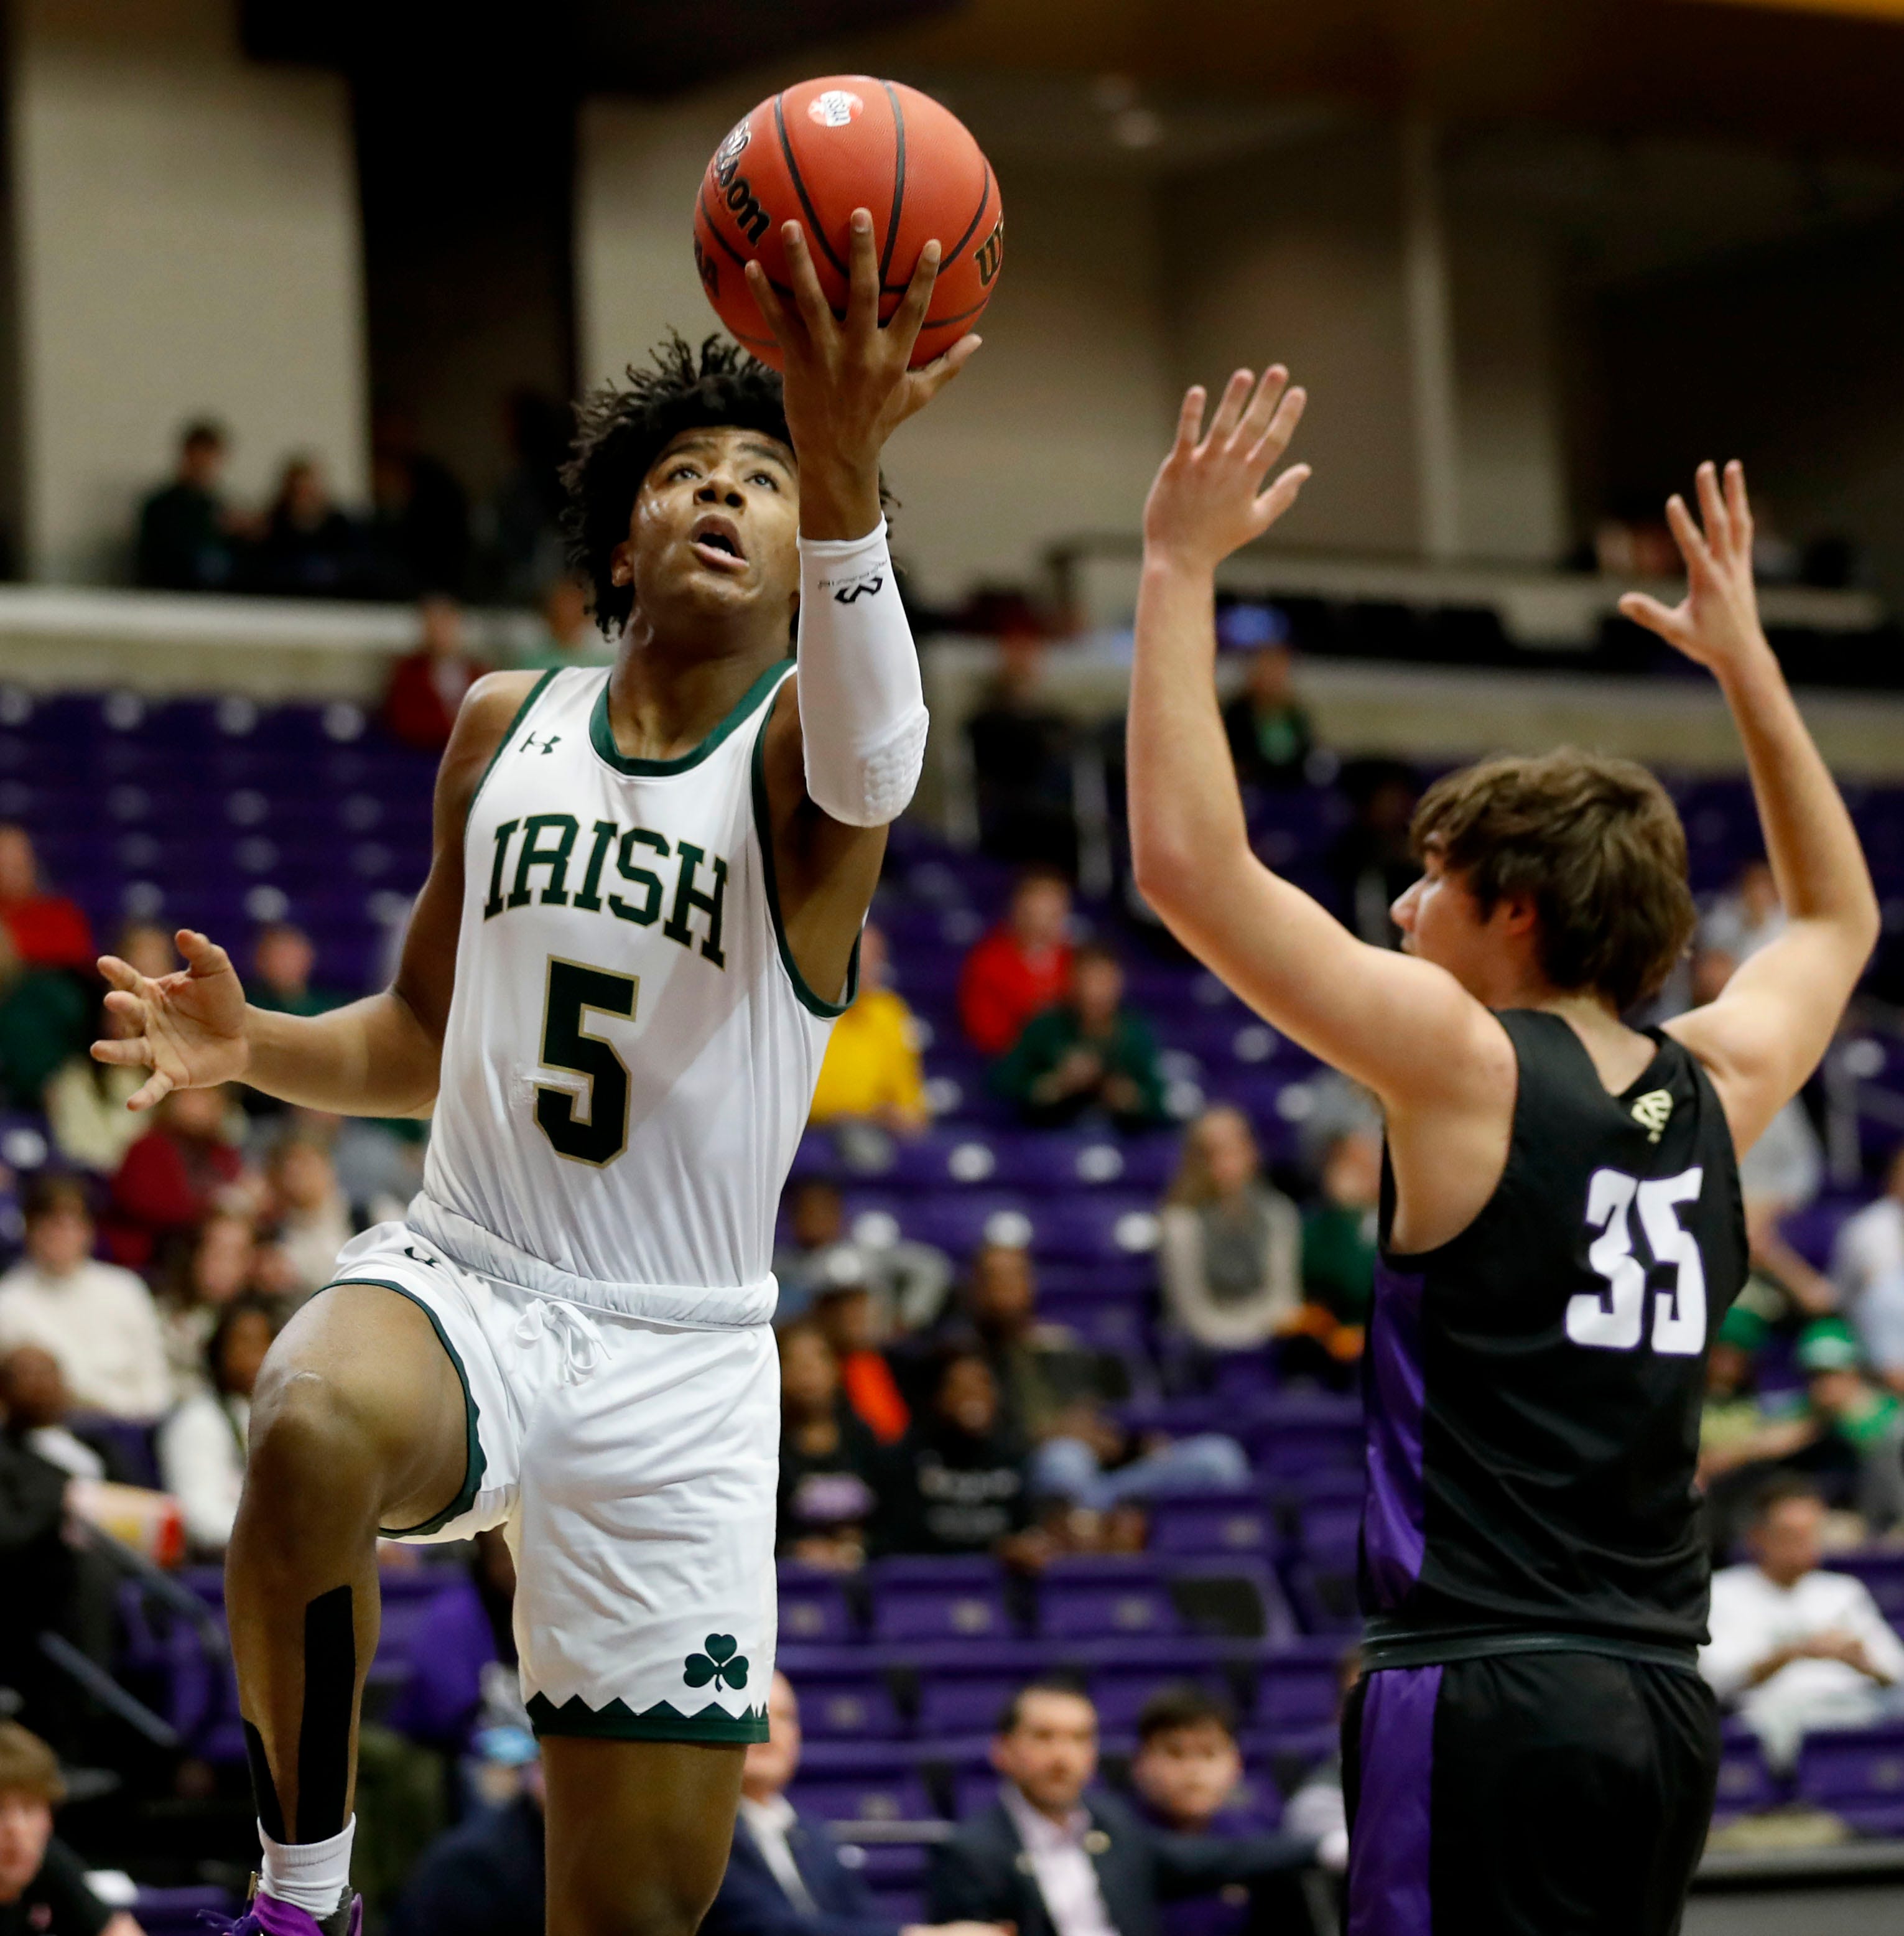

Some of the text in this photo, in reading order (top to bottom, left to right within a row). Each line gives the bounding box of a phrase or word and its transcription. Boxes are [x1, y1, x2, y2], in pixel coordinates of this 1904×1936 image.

[483, 812, 728, 972] IRISH
[532, 952, 641, 1169] 5
[1564, 1164, 1707, 1356] 35
